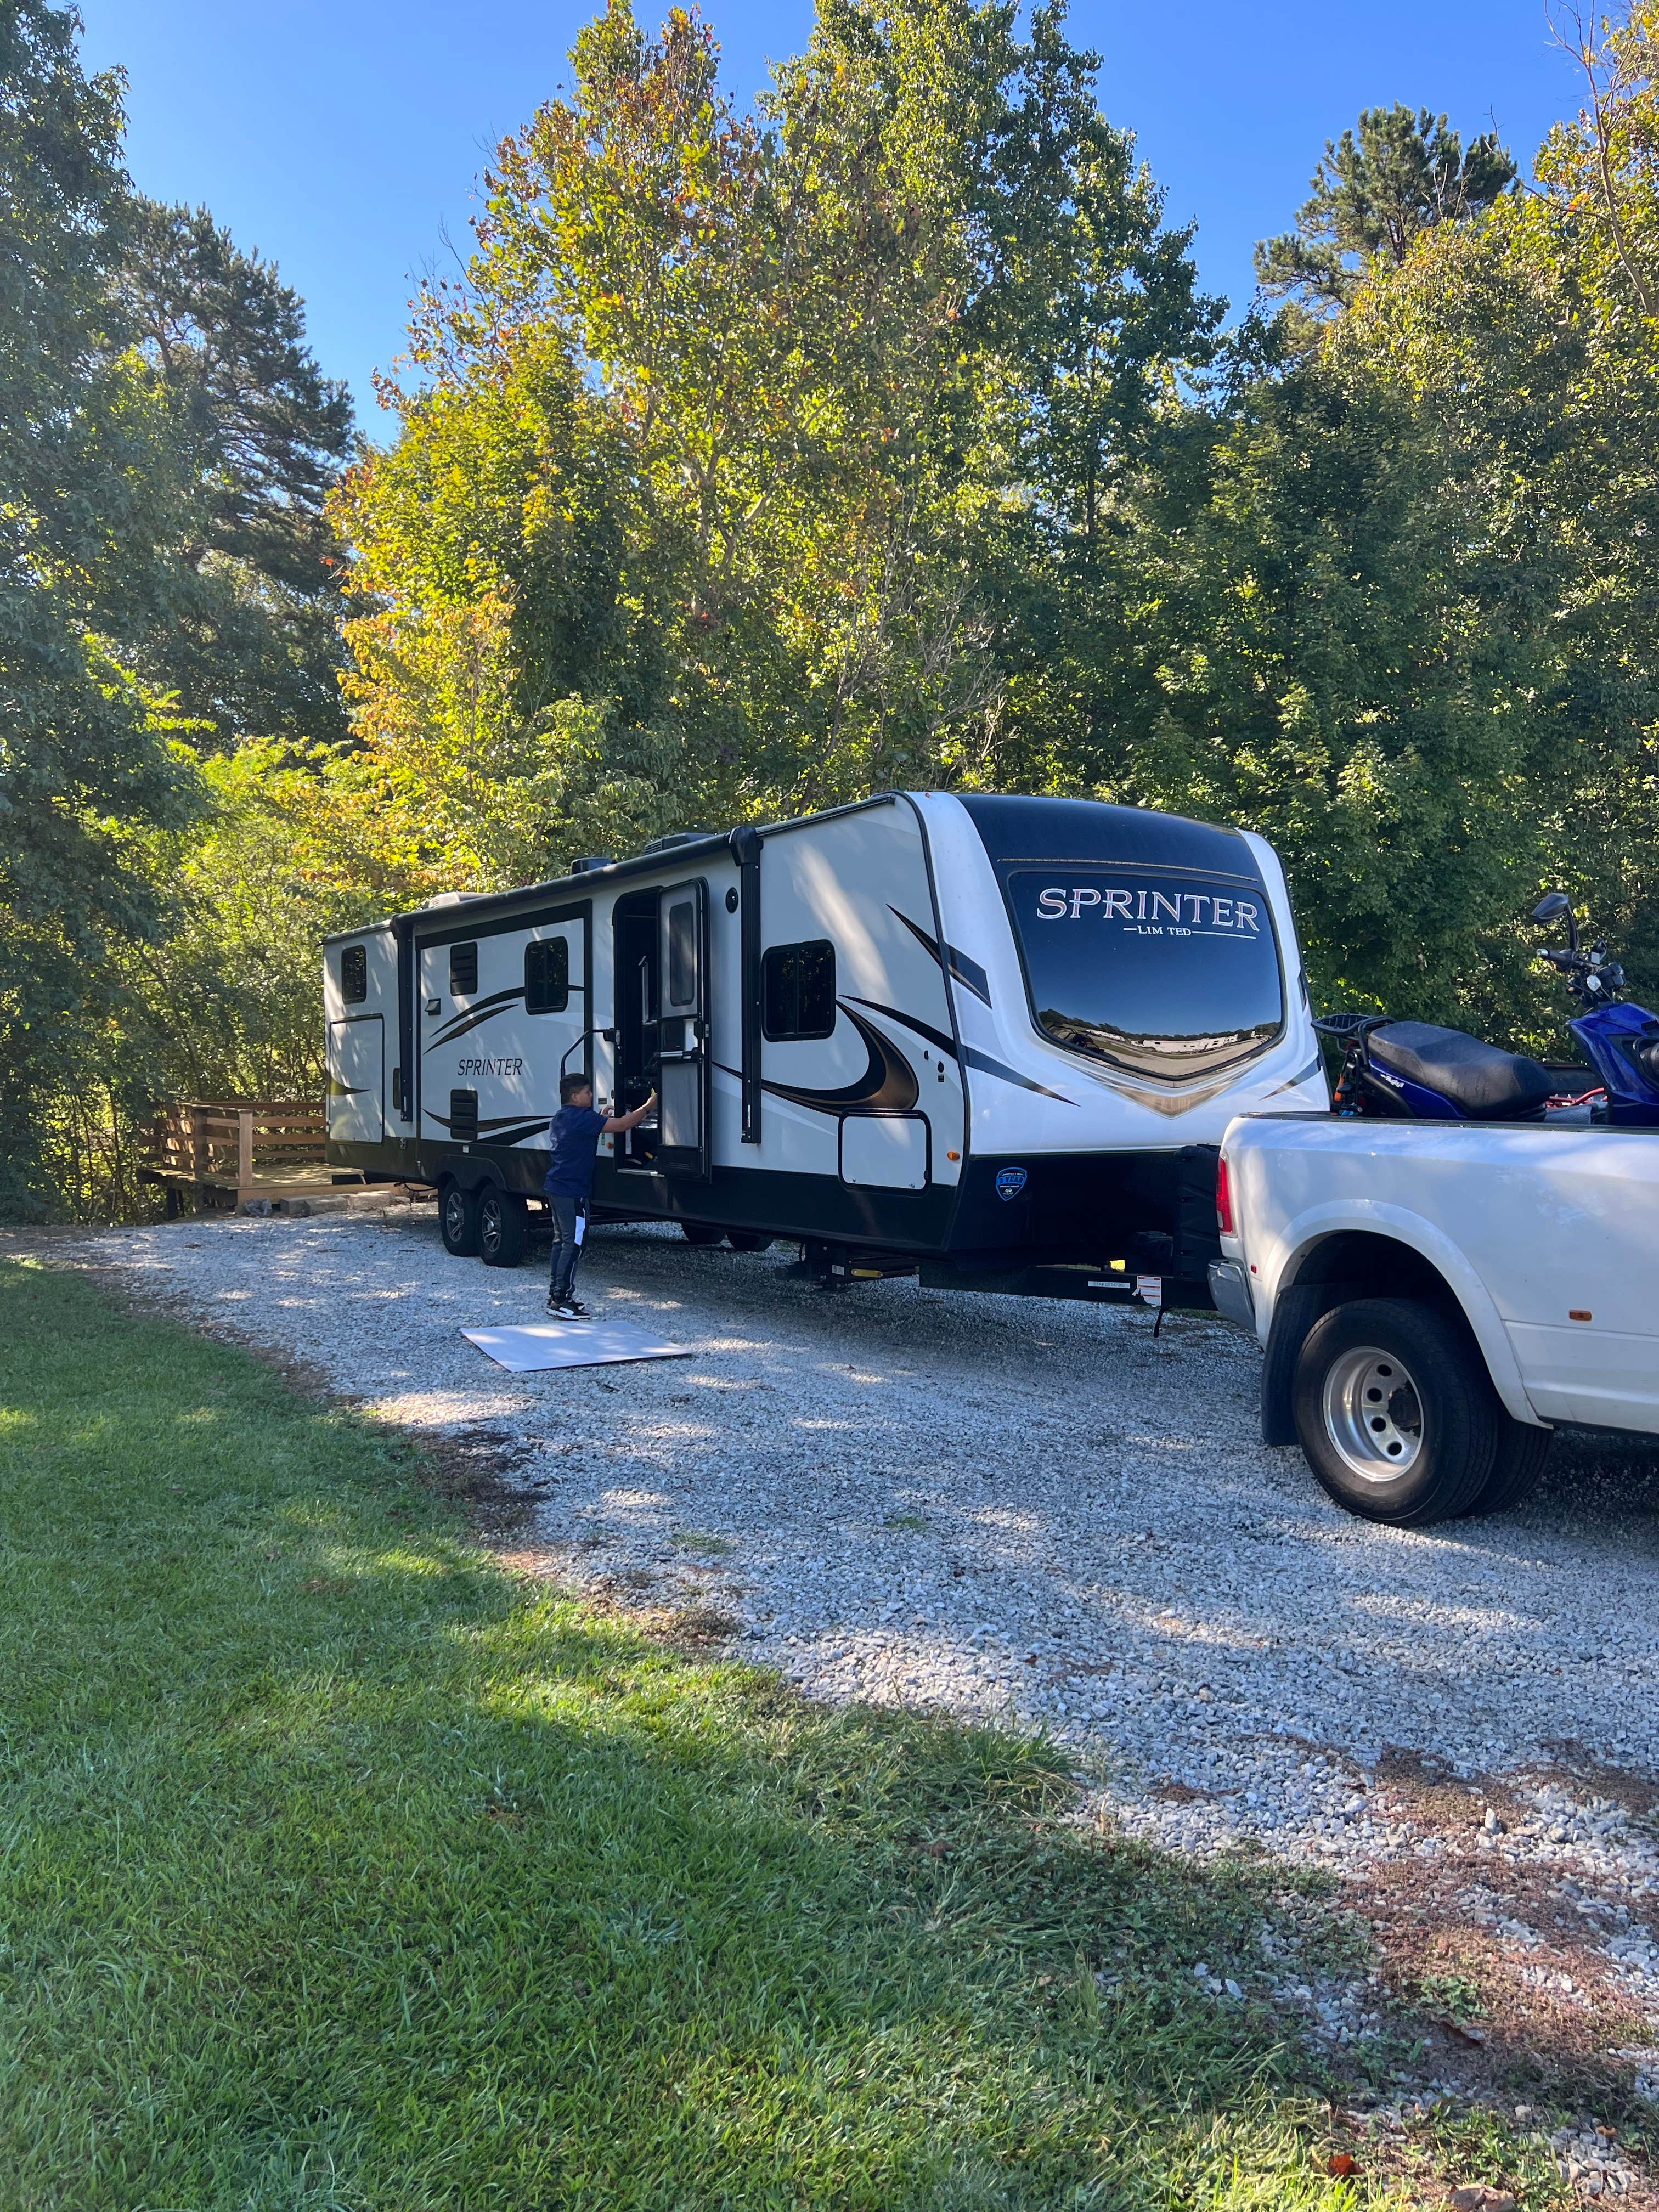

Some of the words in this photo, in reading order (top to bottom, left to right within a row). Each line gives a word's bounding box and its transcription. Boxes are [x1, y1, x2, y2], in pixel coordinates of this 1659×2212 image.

[1036, 888, 1260, 932] SPRINTER
[1136, 924, 1192, 936] LIMTED
[457, 1058, 523, 1076] SPRINTER
